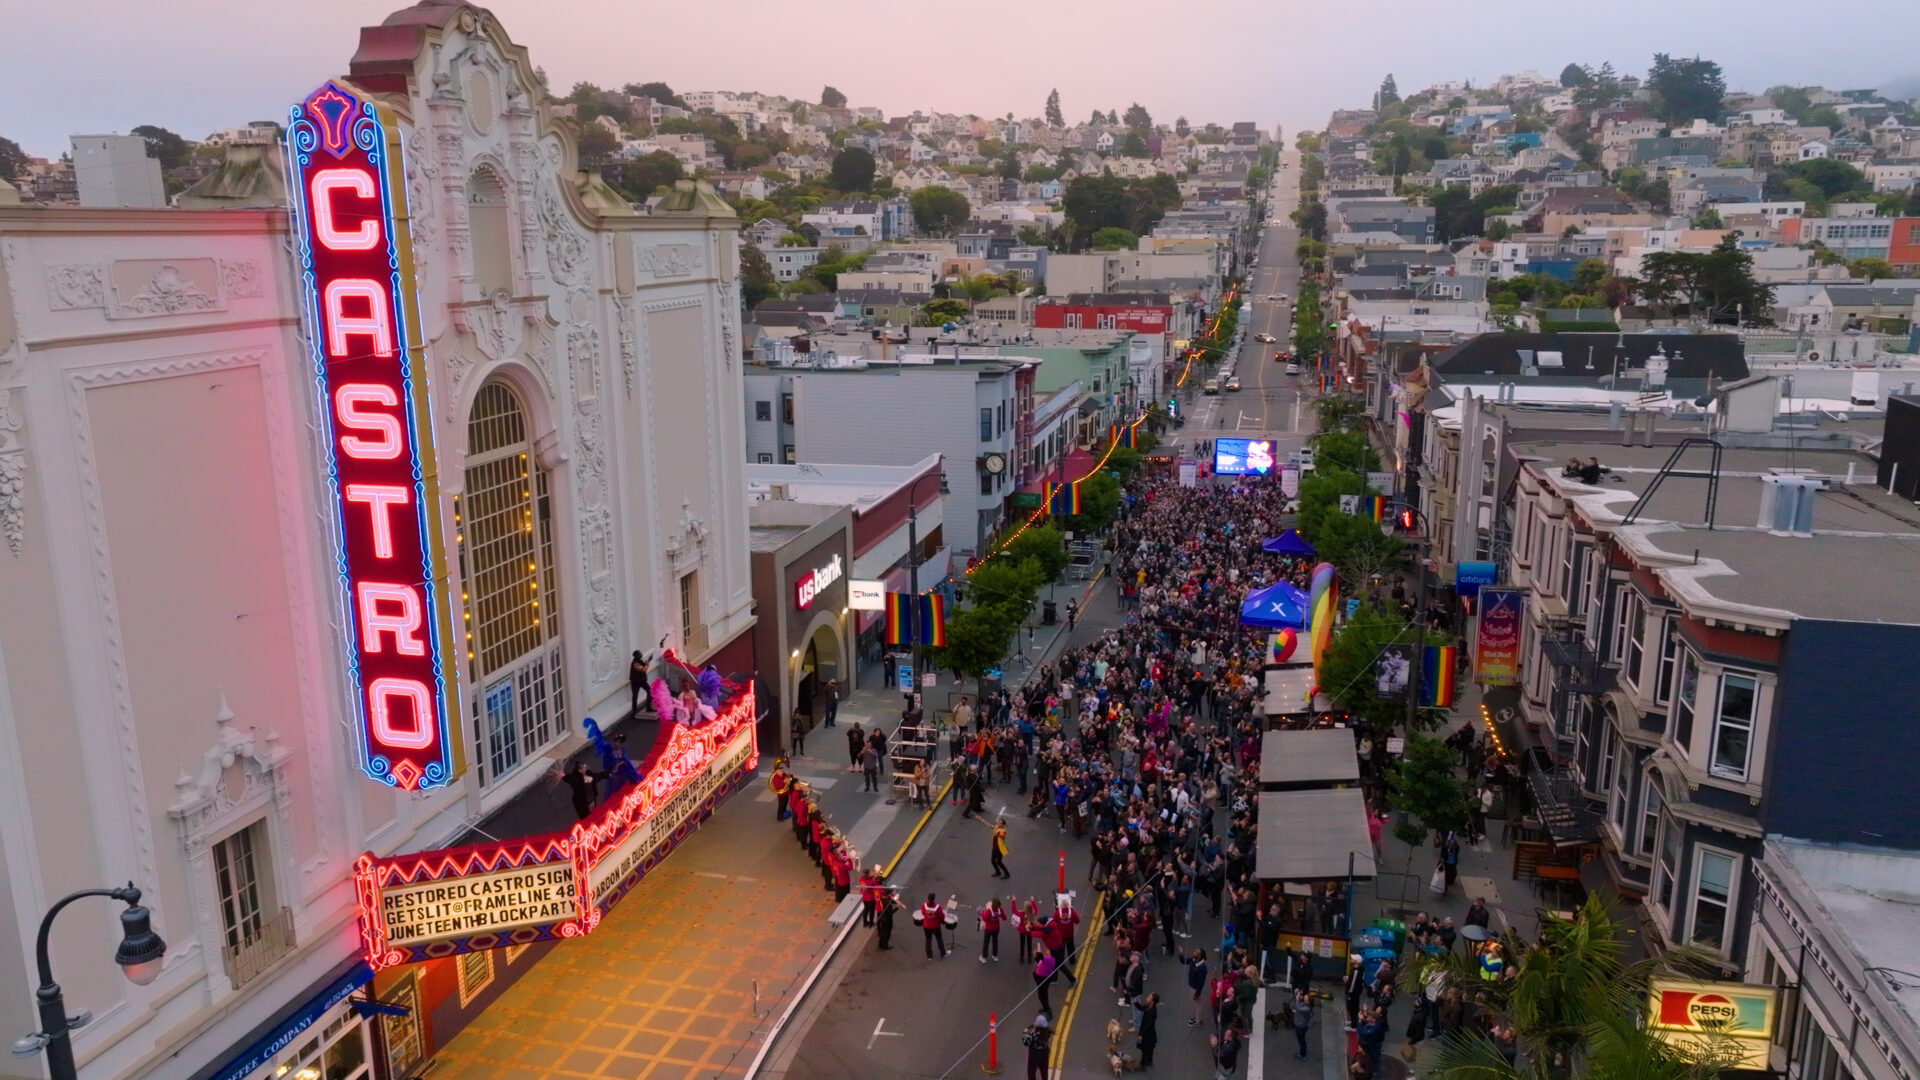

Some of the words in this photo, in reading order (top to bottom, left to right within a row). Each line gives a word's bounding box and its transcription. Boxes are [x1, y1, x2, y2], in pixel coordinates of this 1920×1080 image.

[310, 167, 436, 749] CASTRO
[653, 741, 704, 797] CASTRO
[632, 840, 648, 864] DUST
[649, 815, 675, 848] GETTING
[675, 810, 680, 822] A
[384, 884, 467, 910] RESTORED
[470, 874, 534, 896] CASTRO
[537, 868, 573, 886] SIGN
[556, 884, 575, 898] 48
[1690, 1003, 1736, 1017] PEPSI
[263, 1014, 314, 1059] COMPANY
